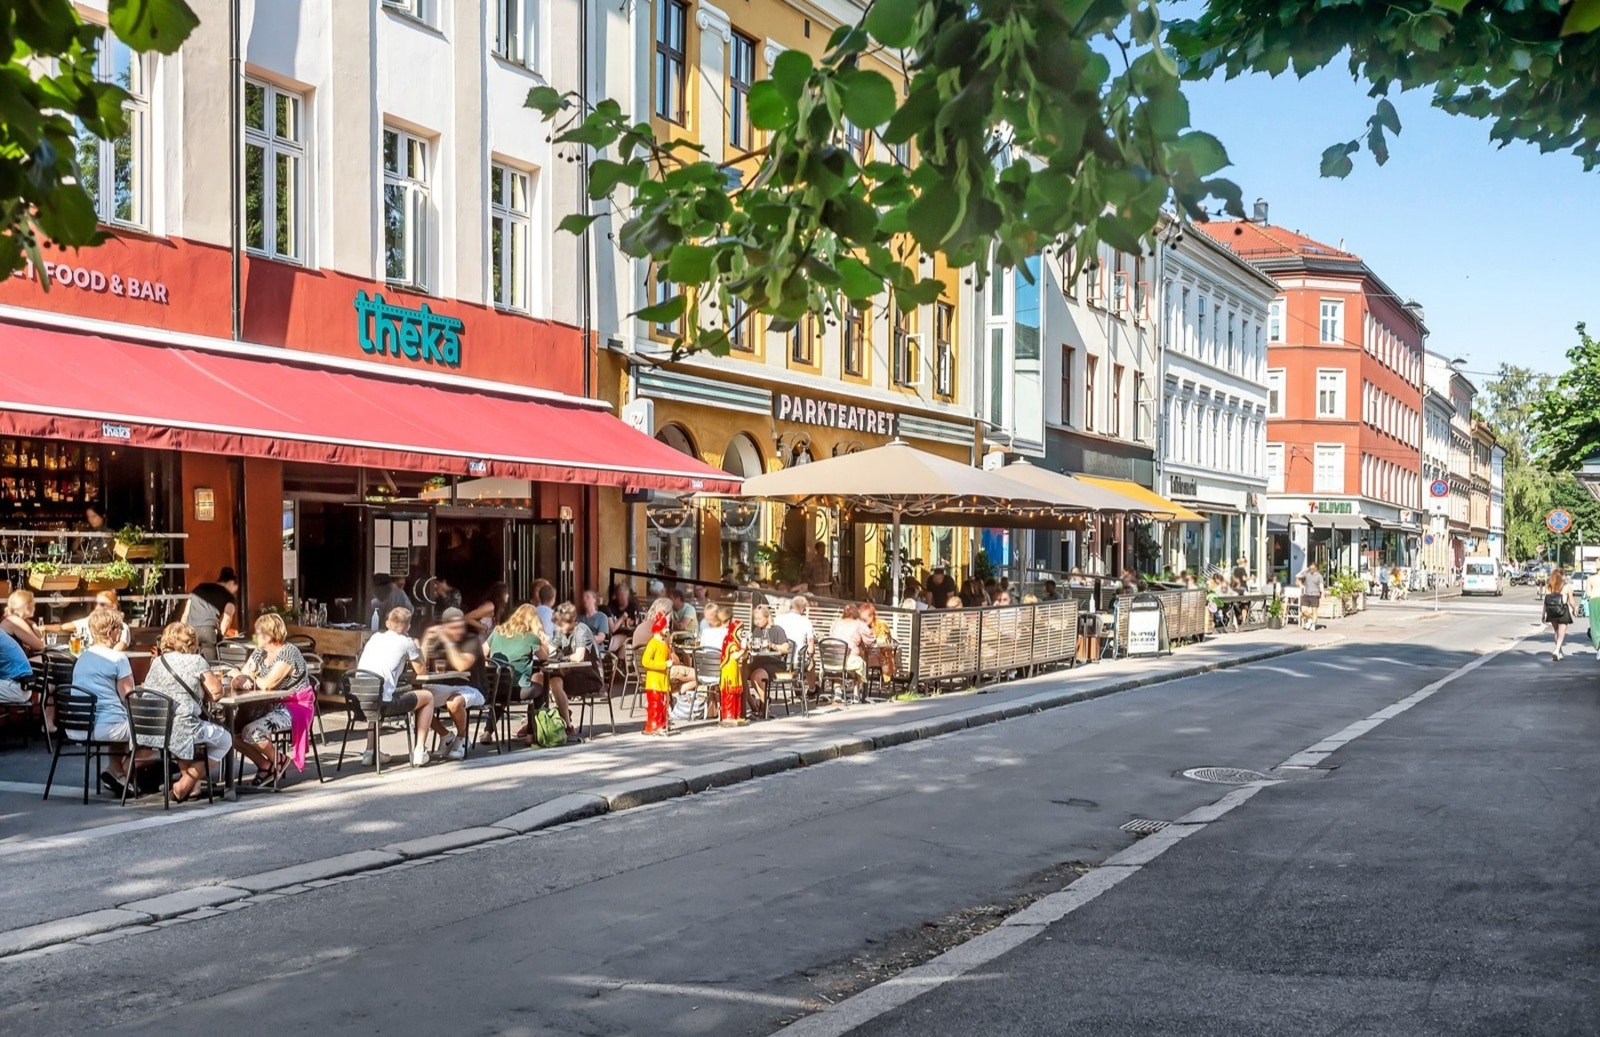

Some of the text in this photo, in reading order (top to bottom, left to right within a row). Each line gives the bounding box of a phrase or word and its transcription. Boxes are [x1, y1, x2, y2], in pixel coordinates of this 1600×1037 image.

[43, 261, 106, 291] FOOD
[109, 274, 124, 295] &
[127, 277, 168, 303] BAR
[354, 289, 462, 364] theka
[779, 394, 895, 436] PARKTEATRET
